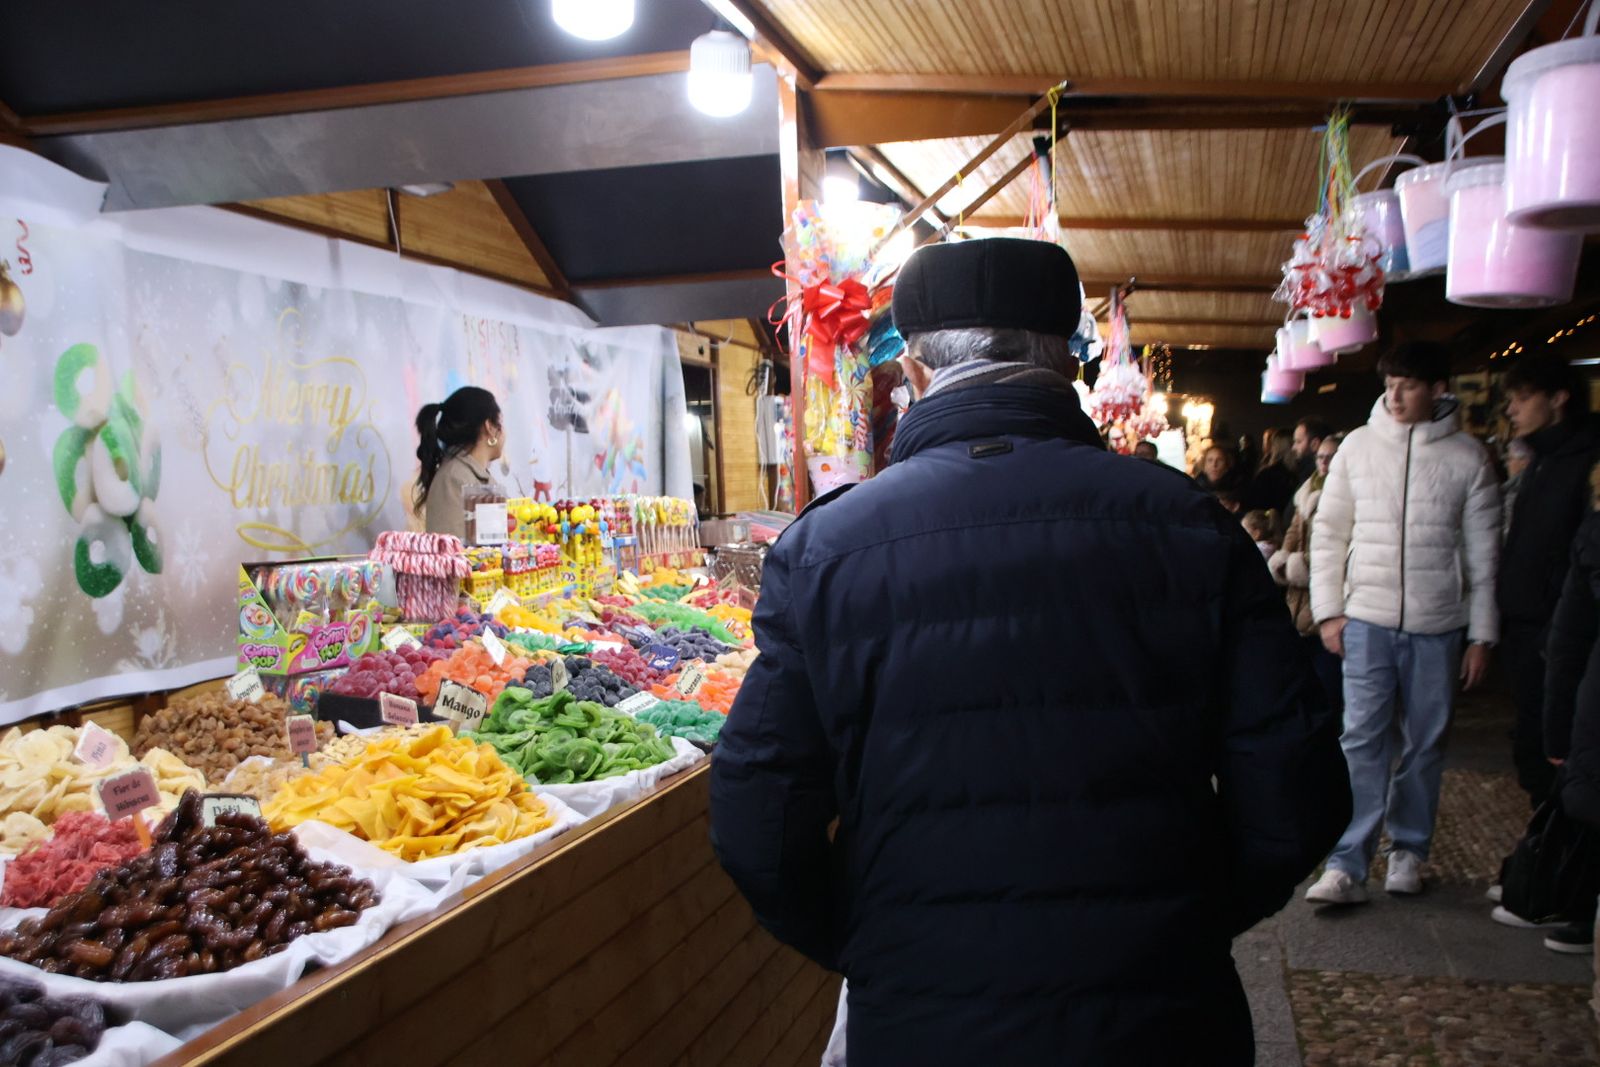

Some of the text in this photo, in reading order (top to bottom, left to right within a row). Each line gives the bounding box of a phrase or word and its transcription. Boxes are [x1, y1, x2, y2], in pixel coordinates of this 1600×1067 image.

[230, 444, 376, 509] Christmas
[442, 695, 480, 719] Mango
[113, 779, 141, 796] Flor de
